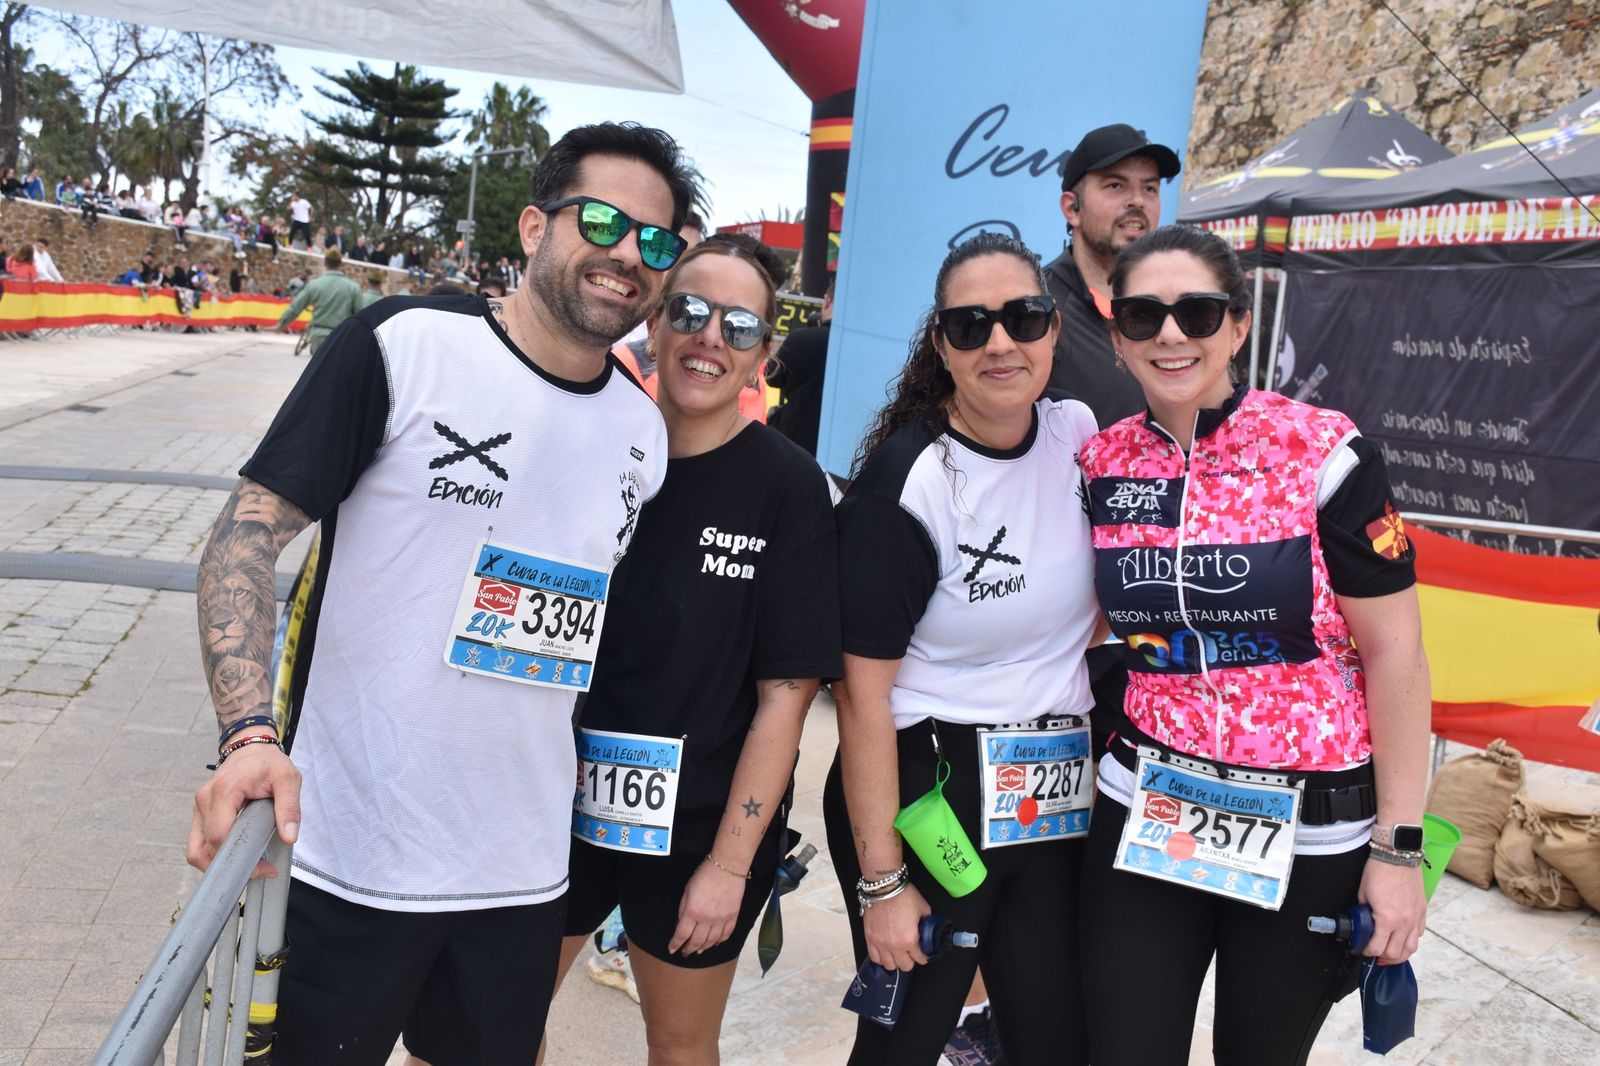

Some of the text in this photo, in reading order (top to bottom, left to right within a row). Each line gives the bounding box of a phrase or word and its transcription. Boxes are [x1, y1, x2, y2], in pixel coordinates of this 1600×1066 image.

[1290, 210, 1377, 252] TERCIO
[1502, 198, 1547, 241] DE
[1552, 194, 1600, 240] AL
[1105, 494, 1162, 511] CEUTA
[699, 526, 767, 555] Super
[1117, 547, 1251, 584] Alberto
[477, 589, 518, 606] San Pablo
[521, 592, 598, 645] 3394
[1108, 607, 1278, 624] MESON RESTAURANTE
[539, 639, 555, 648] JUAN
[588, 764, 667, 811] 1166
[1031, 759, 1085, 801] 2287
[1144, 800, 1182, 817] San Pablo
[1188, 806, 1283, 860] 2577
